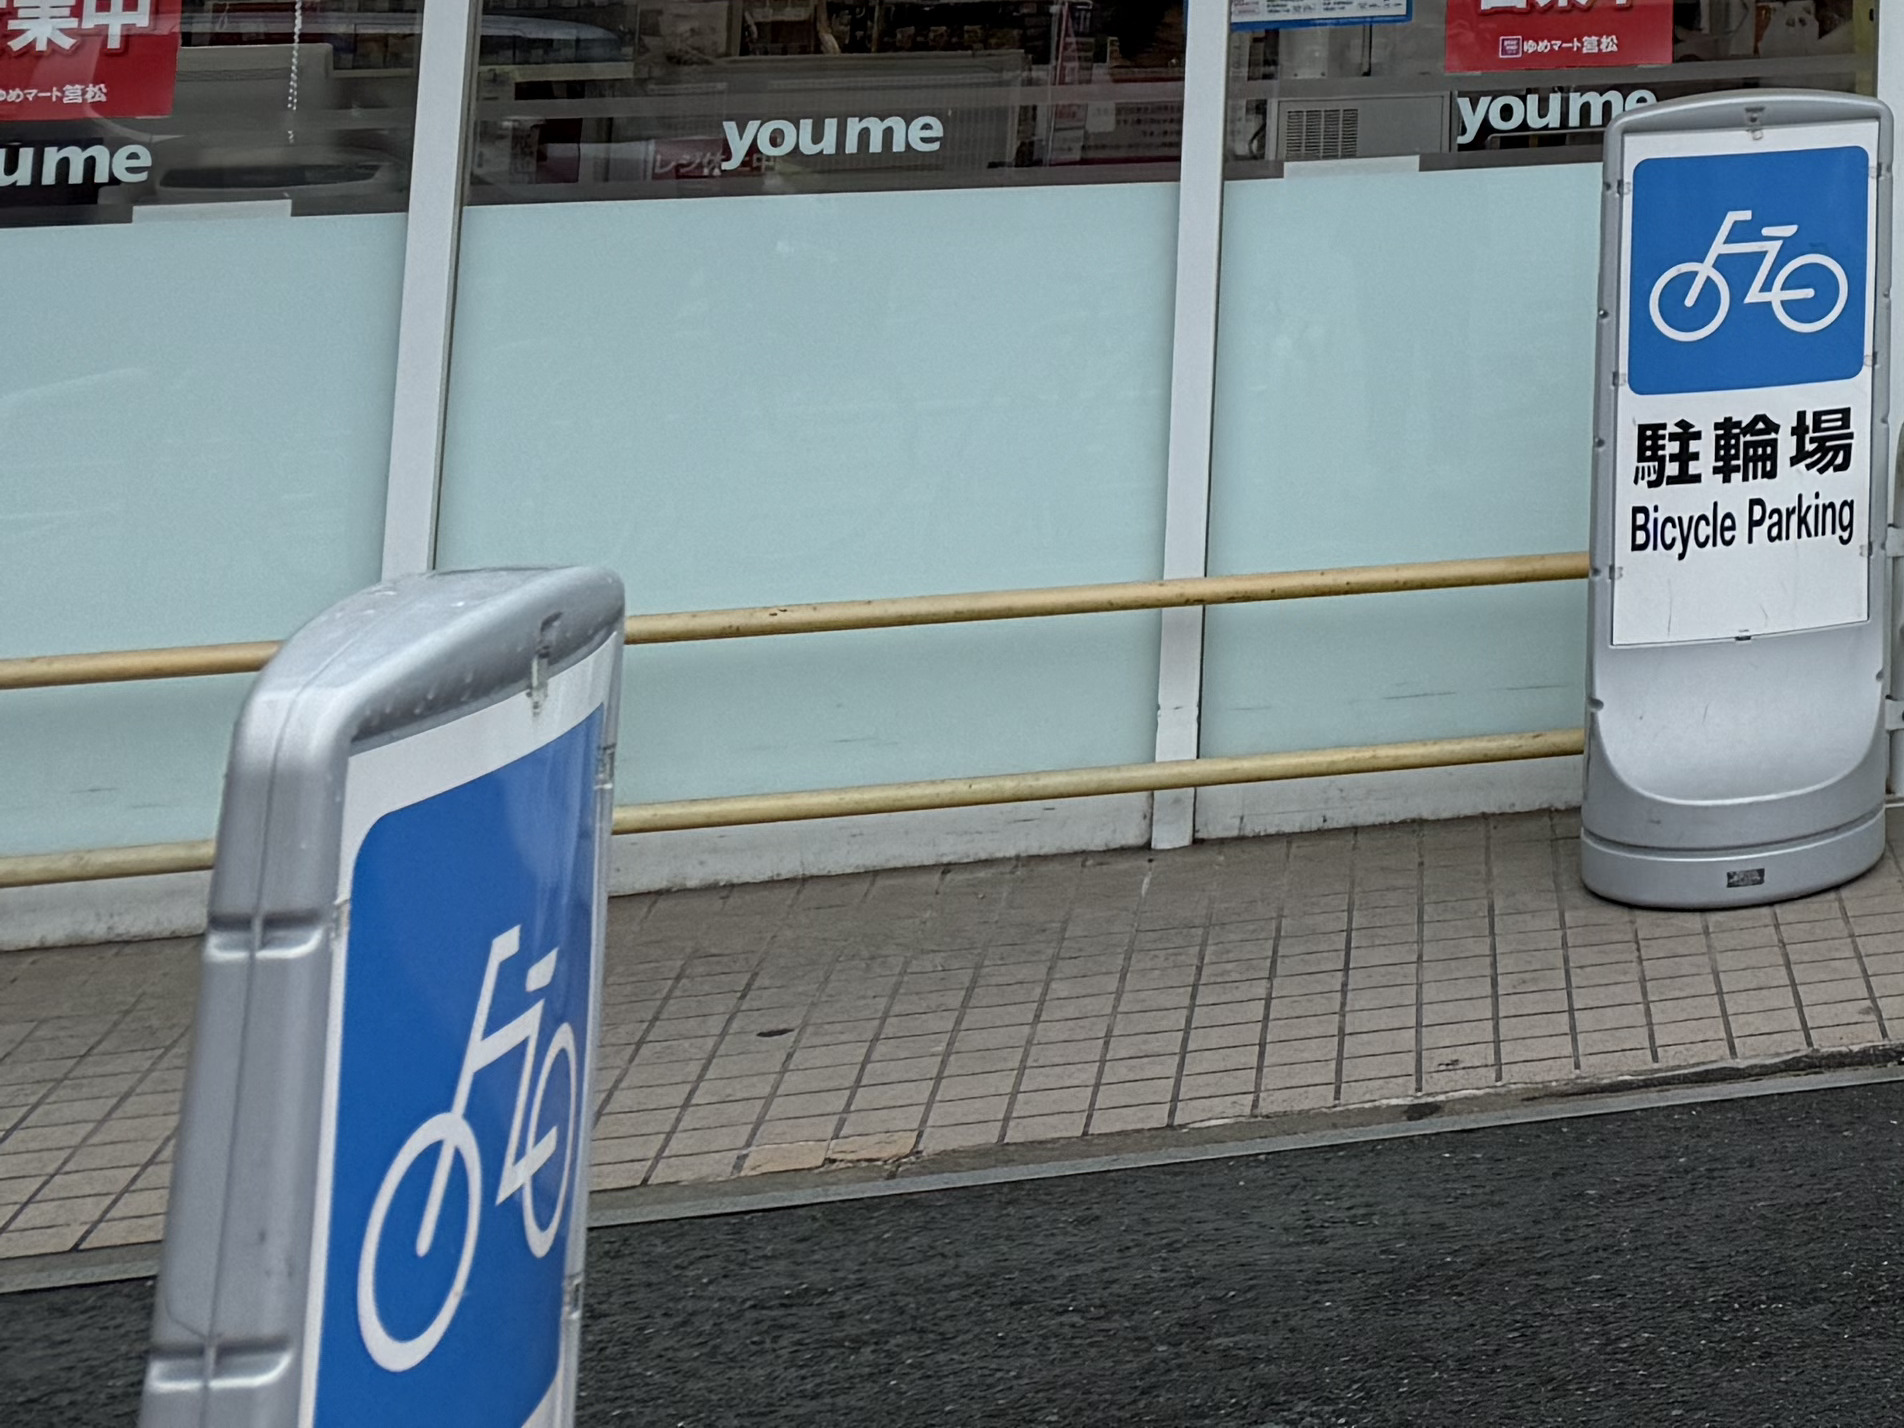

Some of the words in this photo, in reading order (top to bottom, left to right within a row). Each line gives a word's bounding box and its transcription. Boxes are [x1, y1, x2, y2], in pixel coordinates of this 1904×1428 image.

[722, 115, 944, 170] youme
[1633, 407, 1855, 489] 駐輪場
[1631, 500, 1737, 561] Bicycle
[1748, 491, 1855, 546] Parking
